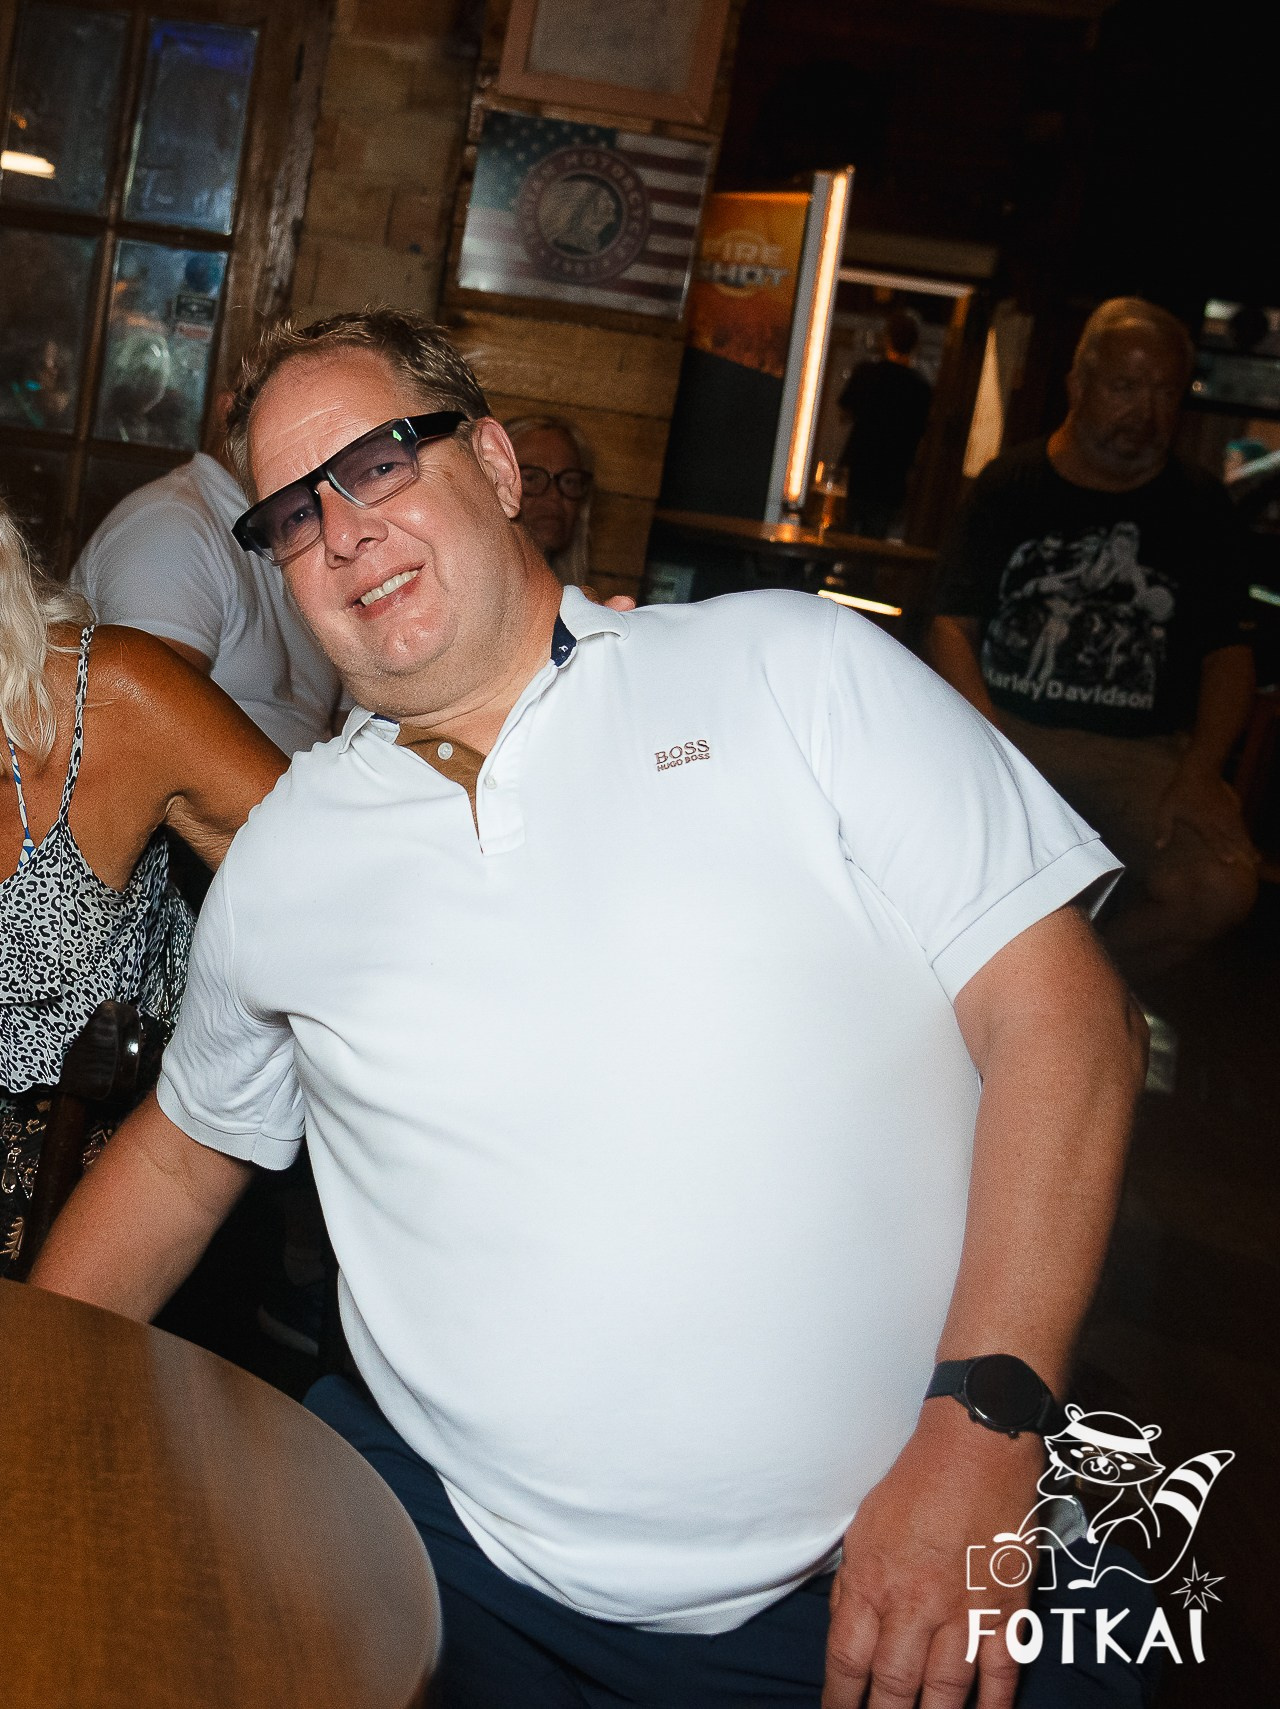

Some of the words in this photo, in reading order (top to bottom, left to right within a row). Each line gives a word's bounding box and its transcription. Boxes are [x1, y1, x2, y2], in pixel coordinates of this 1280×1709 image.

[654, 739, 710, 764] BOSS
[657, 758, 683, 771] HUGO
[685, 752, 711, 764] BOSS
